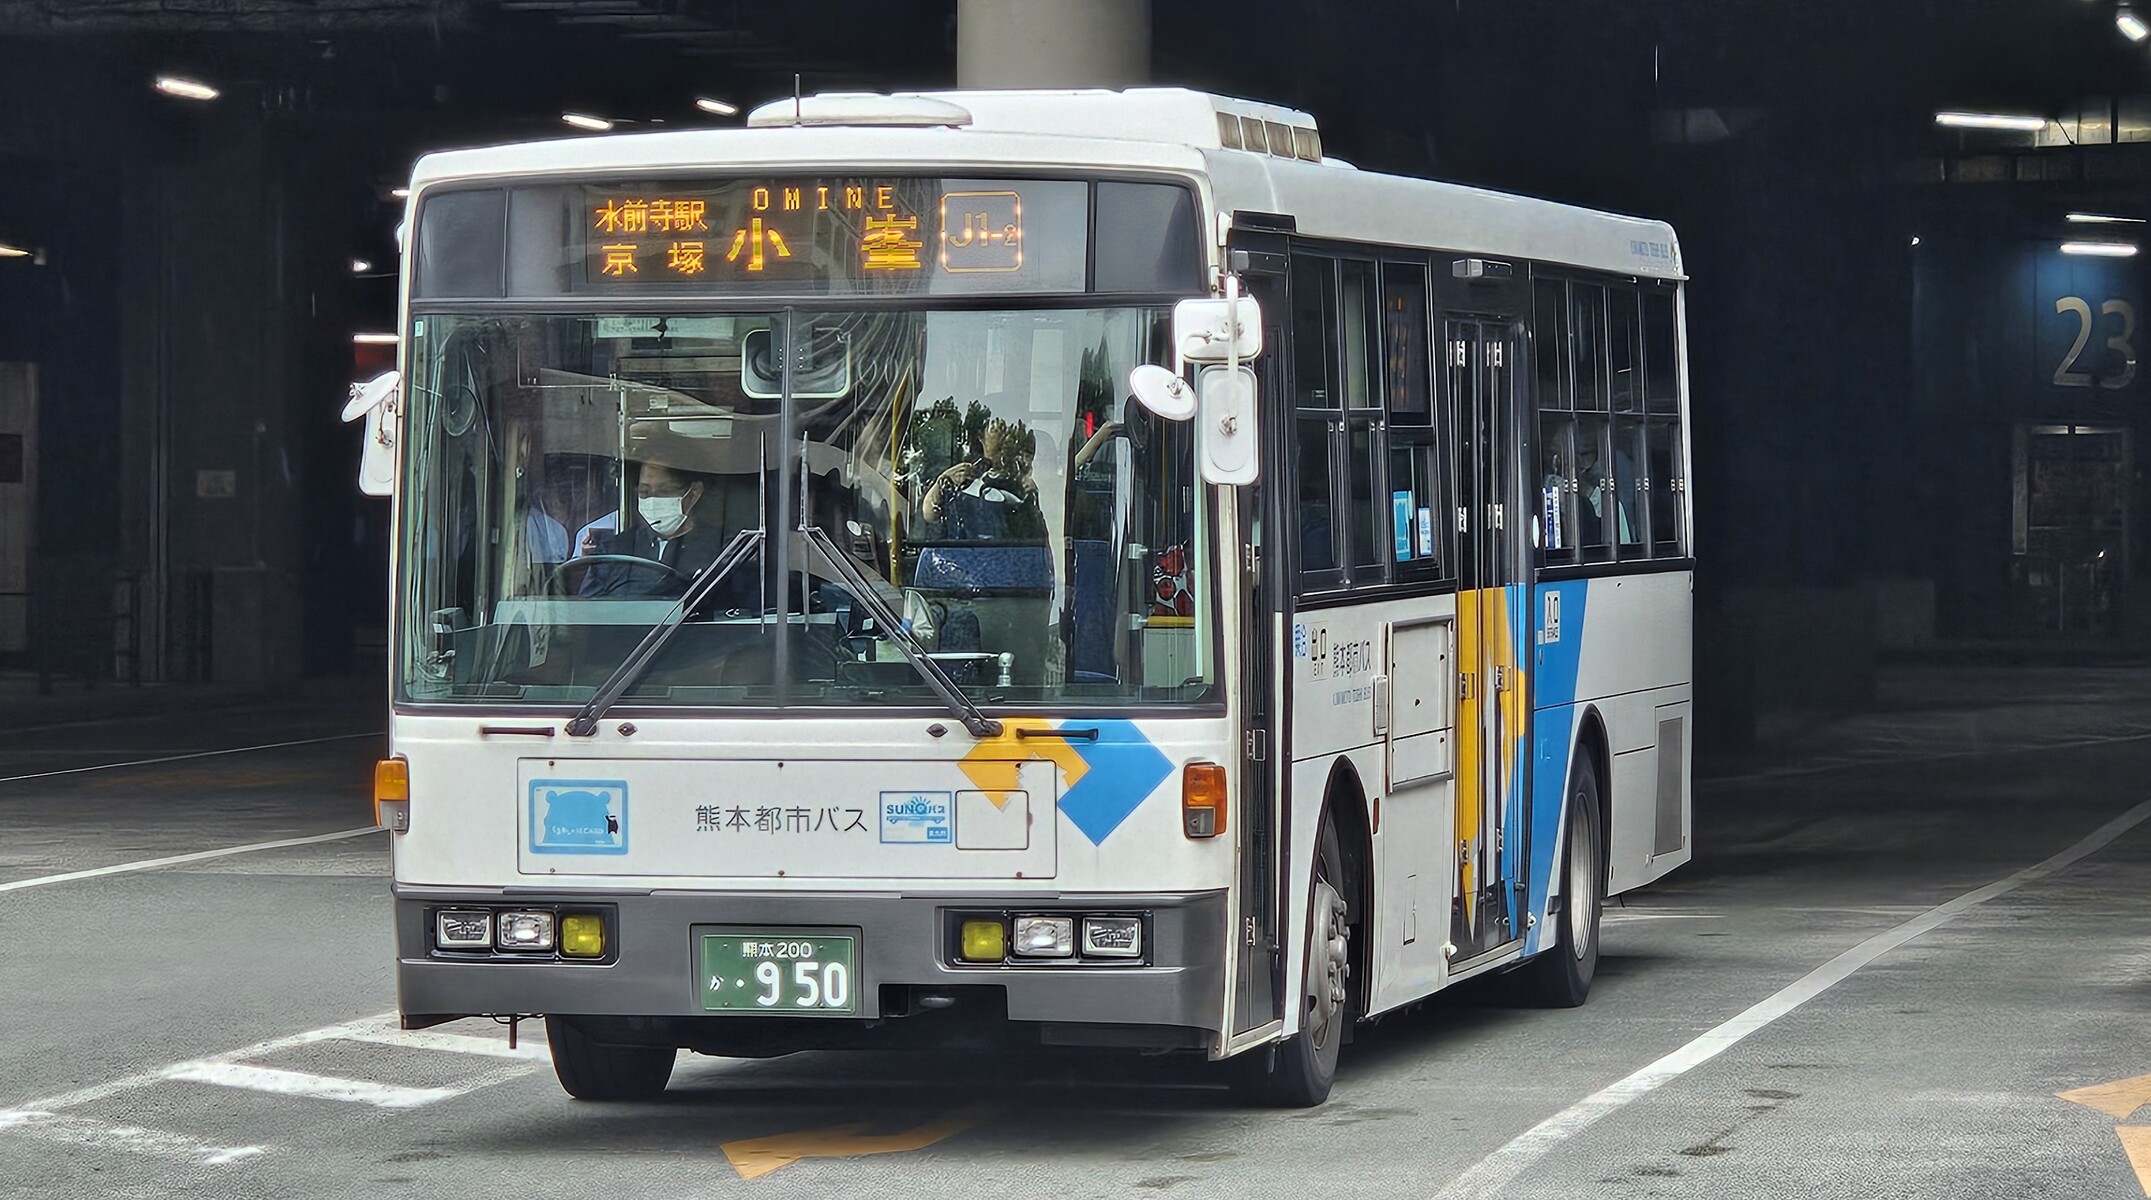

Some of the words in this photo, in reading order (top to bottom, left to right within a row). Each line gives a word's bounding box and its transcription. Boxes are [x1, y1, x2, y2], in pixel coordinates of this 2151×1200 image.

[754, 186, 893, 211] OMINE
[595, 199, 708, 232] 水前寺駅
[949, 212, 1017, 248] J1-2
[2053, 296, 2137, 389] 23
[695, 804, 868, 835] 熊本都市バス
